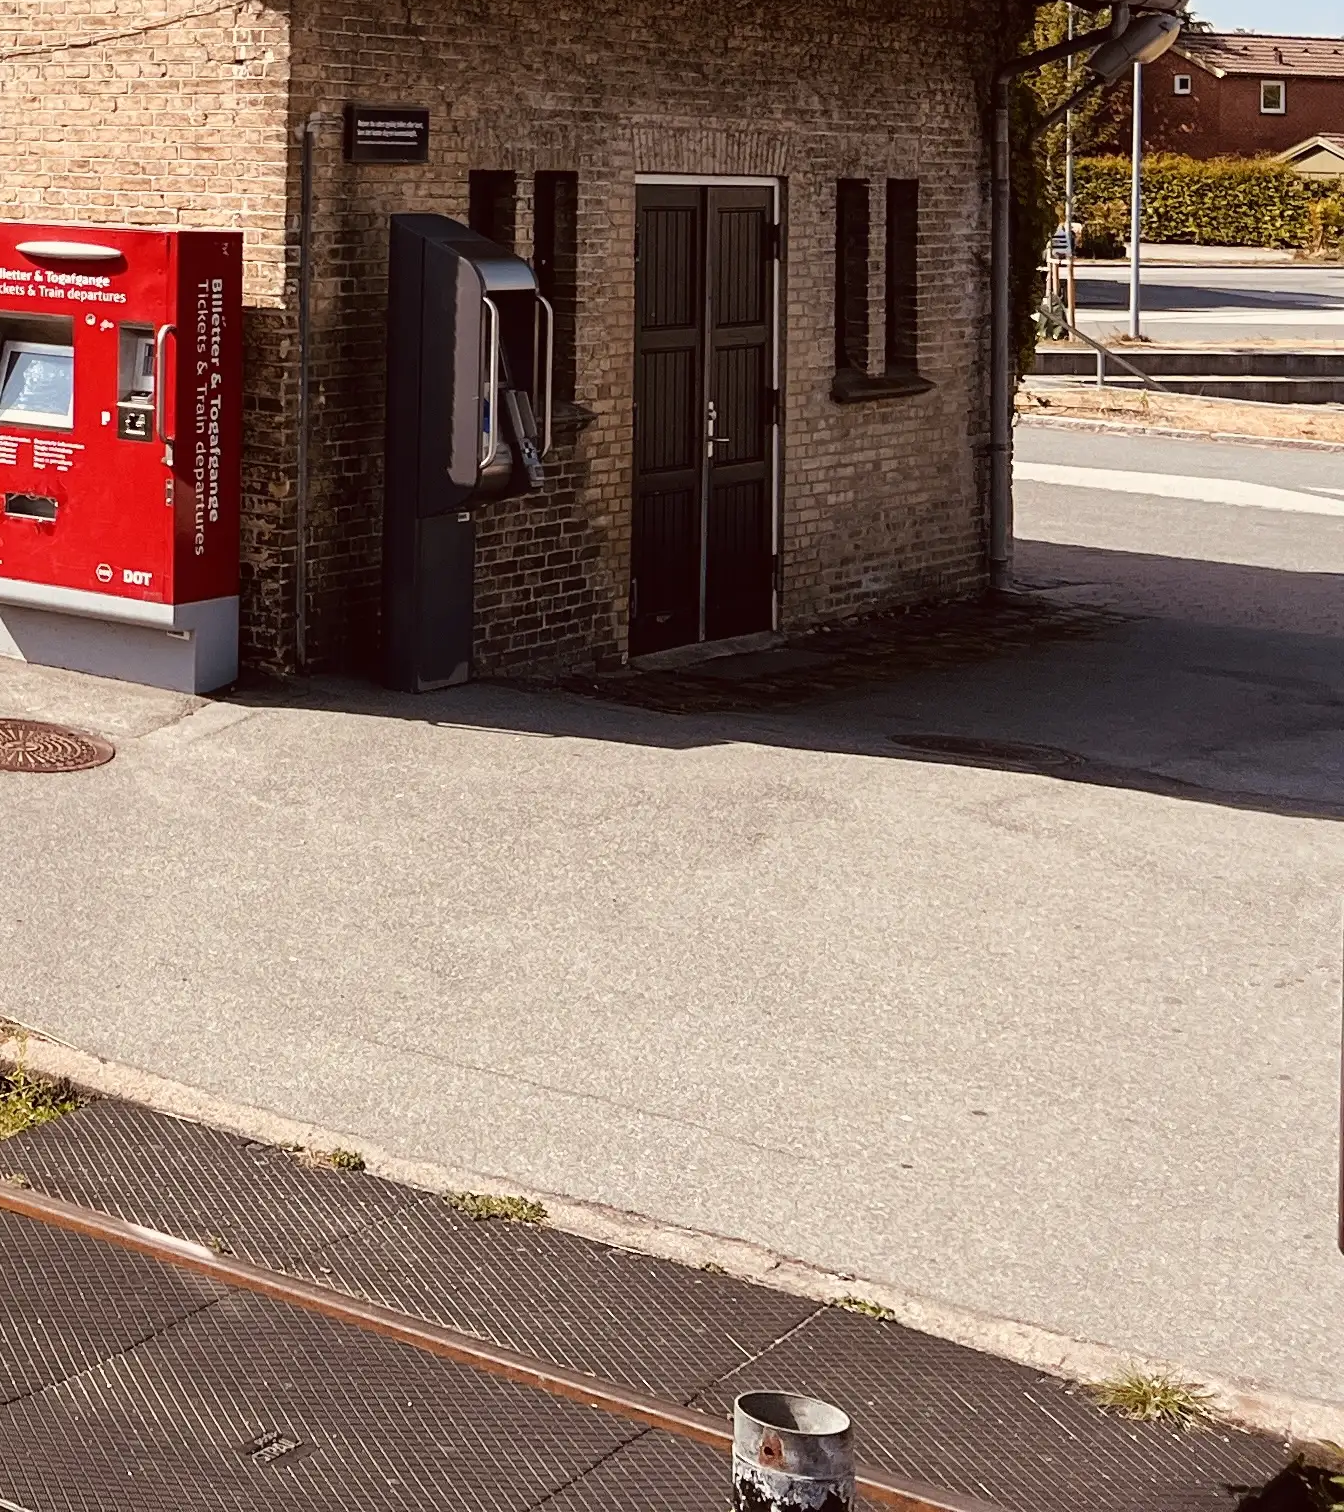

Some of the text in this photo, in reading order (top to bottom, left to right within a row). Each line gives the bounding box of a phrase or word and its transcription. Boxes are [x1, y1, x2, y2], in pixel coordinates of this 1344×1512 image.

[34, 270, 44, 282] &
[44, 270, 110, 288] Togafgange
[27, 284, 36, 296] &
[38, 285, 65, 299] Train
[67, 288, 127, 303] departures
[207, 278, 223, 522] Billetter & Togafgange
[193, 278, 209, 556] Tickets & Train departures
[123, 569, 153, 587] DOT
